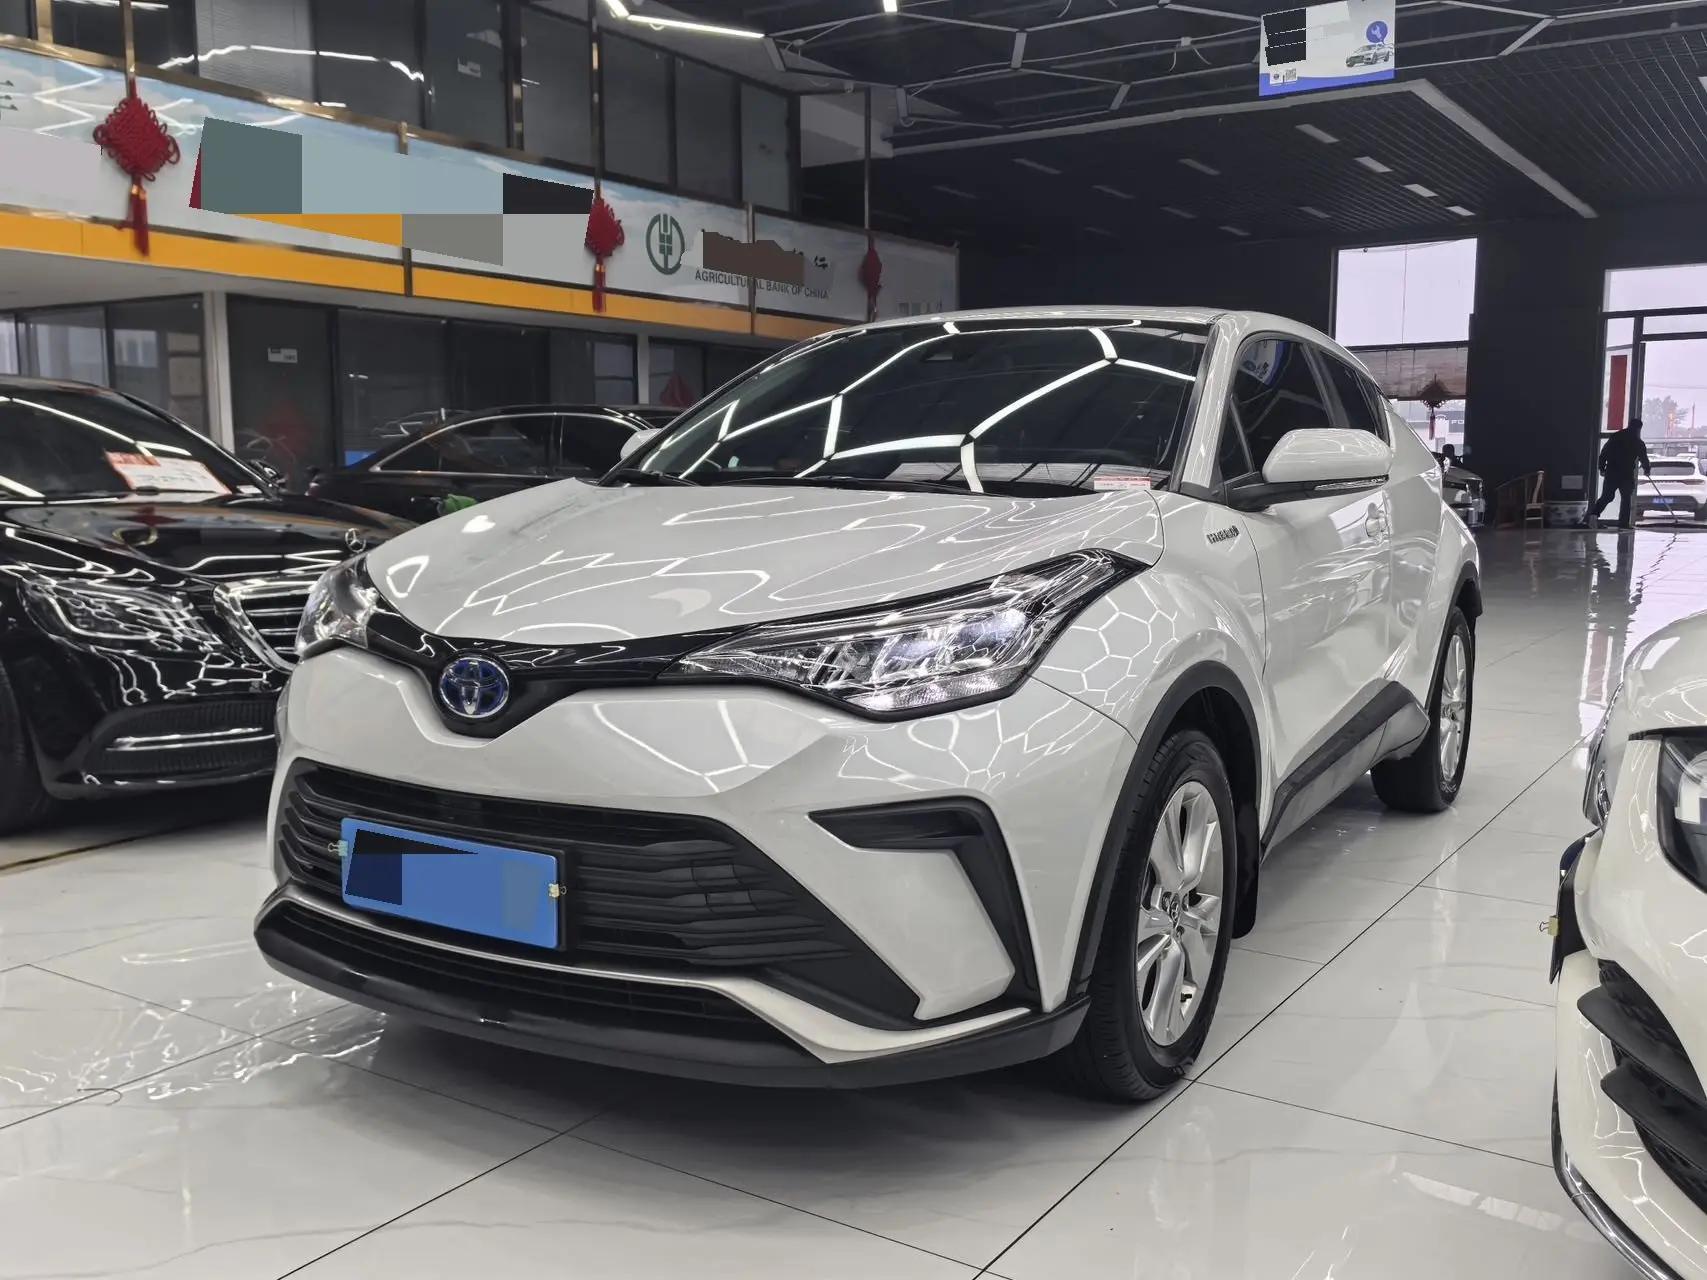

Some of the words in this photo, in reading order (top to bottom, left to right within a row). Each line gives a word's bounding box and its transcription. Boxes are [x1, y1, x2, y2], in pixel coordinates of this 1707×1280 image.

[695, 269, 764, 290] AGRICULTUAL
[766, 280, 790, 295] BANK
[791, 283, 801, 296] OF
[804, 286, 829, 299] CHINA
